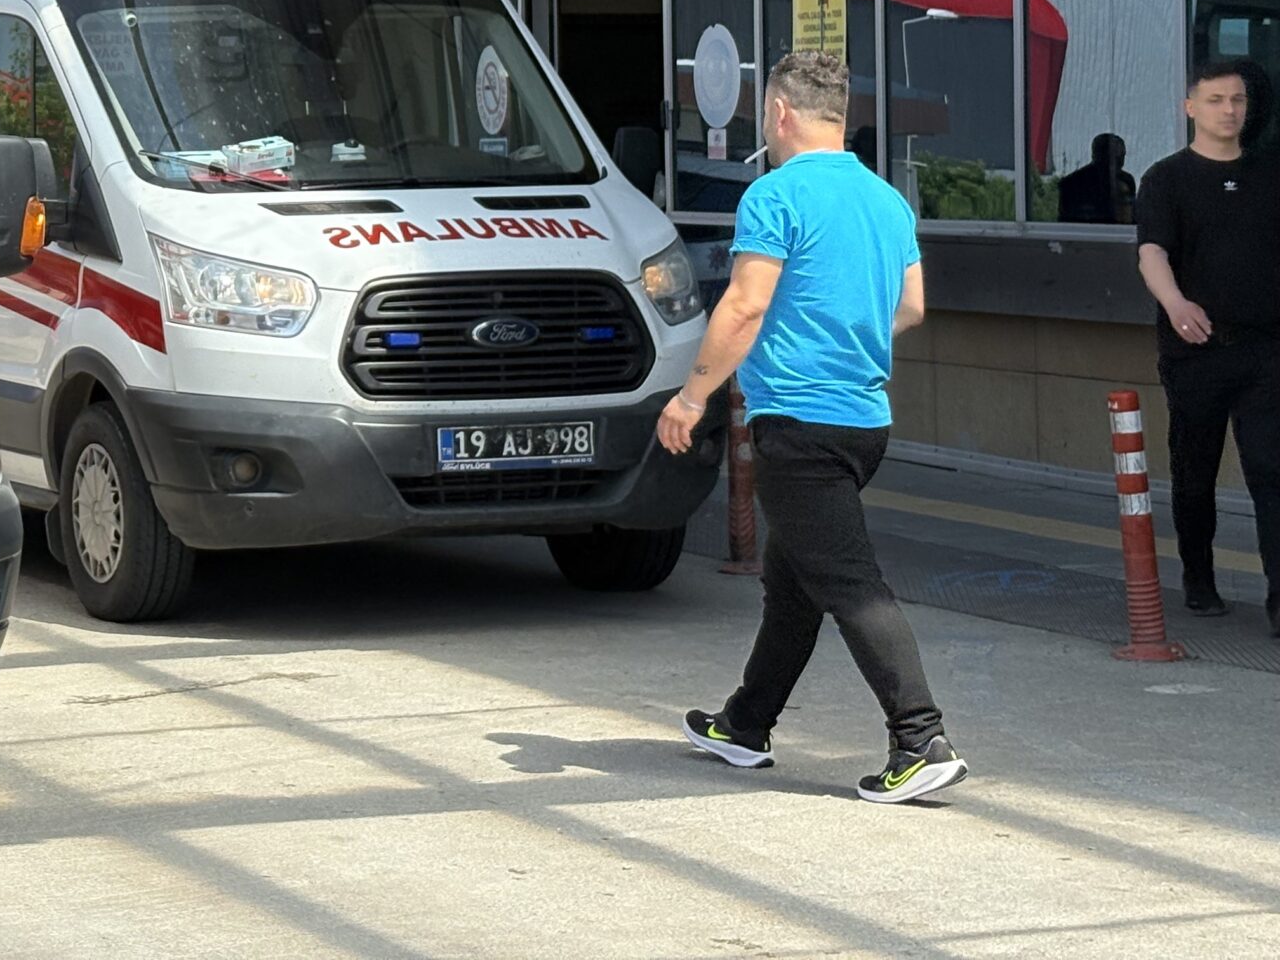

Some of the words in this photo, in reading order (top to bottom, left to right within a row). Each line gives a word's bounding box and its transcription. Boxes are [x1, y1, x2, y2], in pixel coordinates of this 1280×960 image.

[489, 324, 526, 342] Ford
[454, 430, 486, 458] 19
[544, 425, 589, 454] 998
